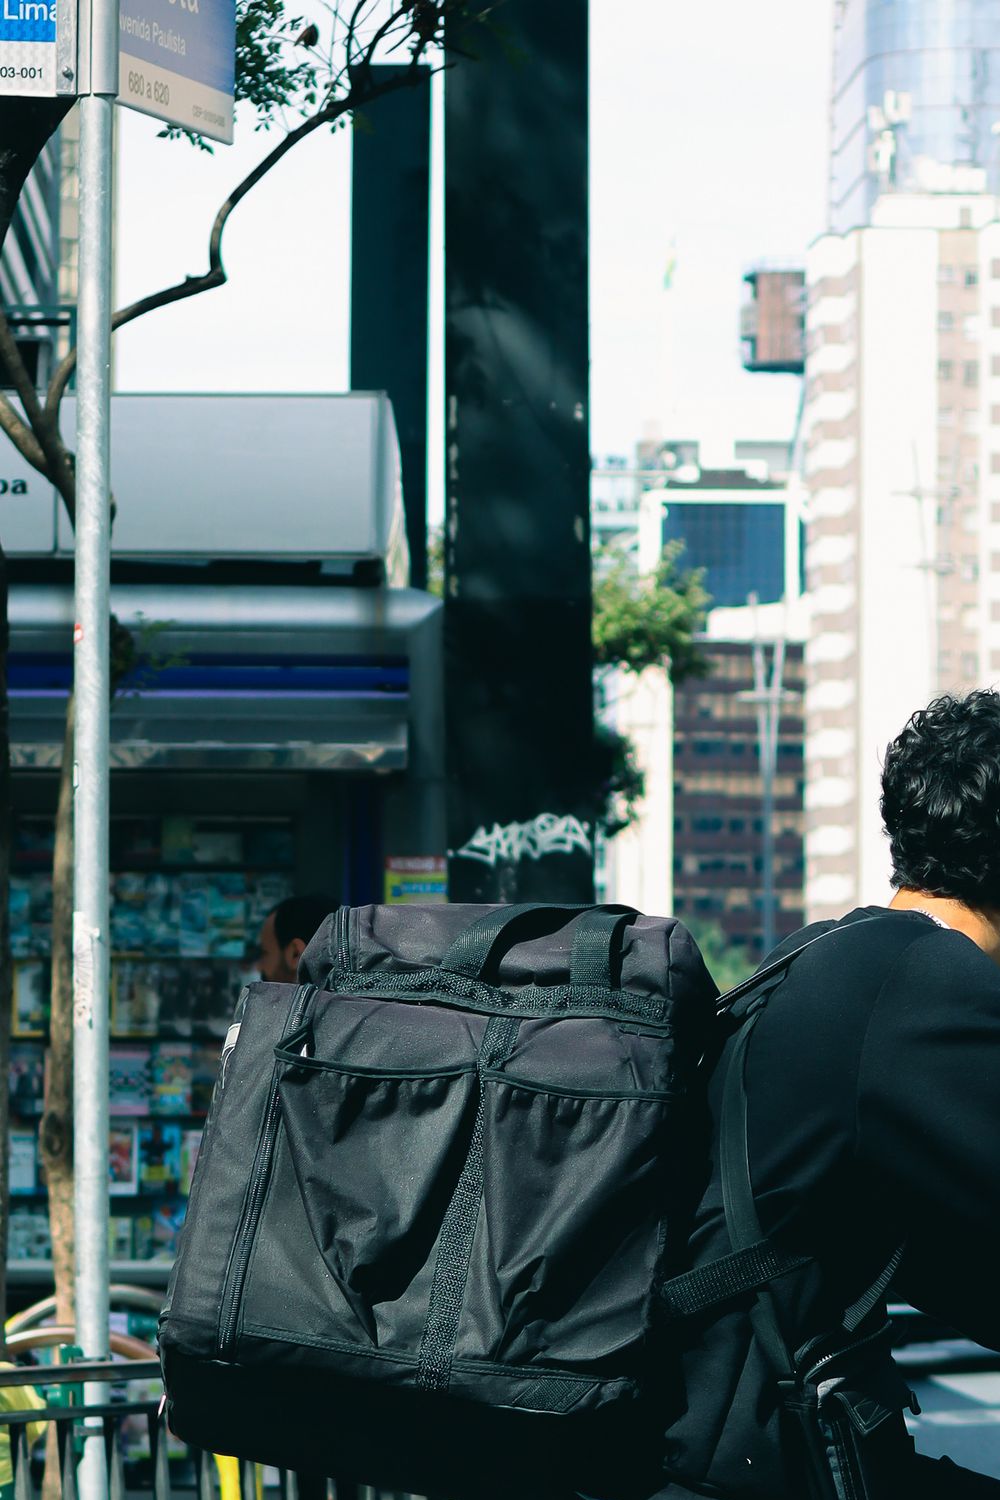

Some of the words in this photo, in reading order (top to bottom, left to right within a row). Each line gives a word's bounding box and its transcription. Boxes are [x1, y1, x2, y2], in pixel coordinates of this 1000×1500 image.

[3, 0, 57, 22] Lima
[119, 14, 151, 42] venida
[152, 22, 186, 56] Paulista
[128, 71, 145, 96] 680
[146, 82, 152, 99] a
[153, 80, 170, 106] 620
